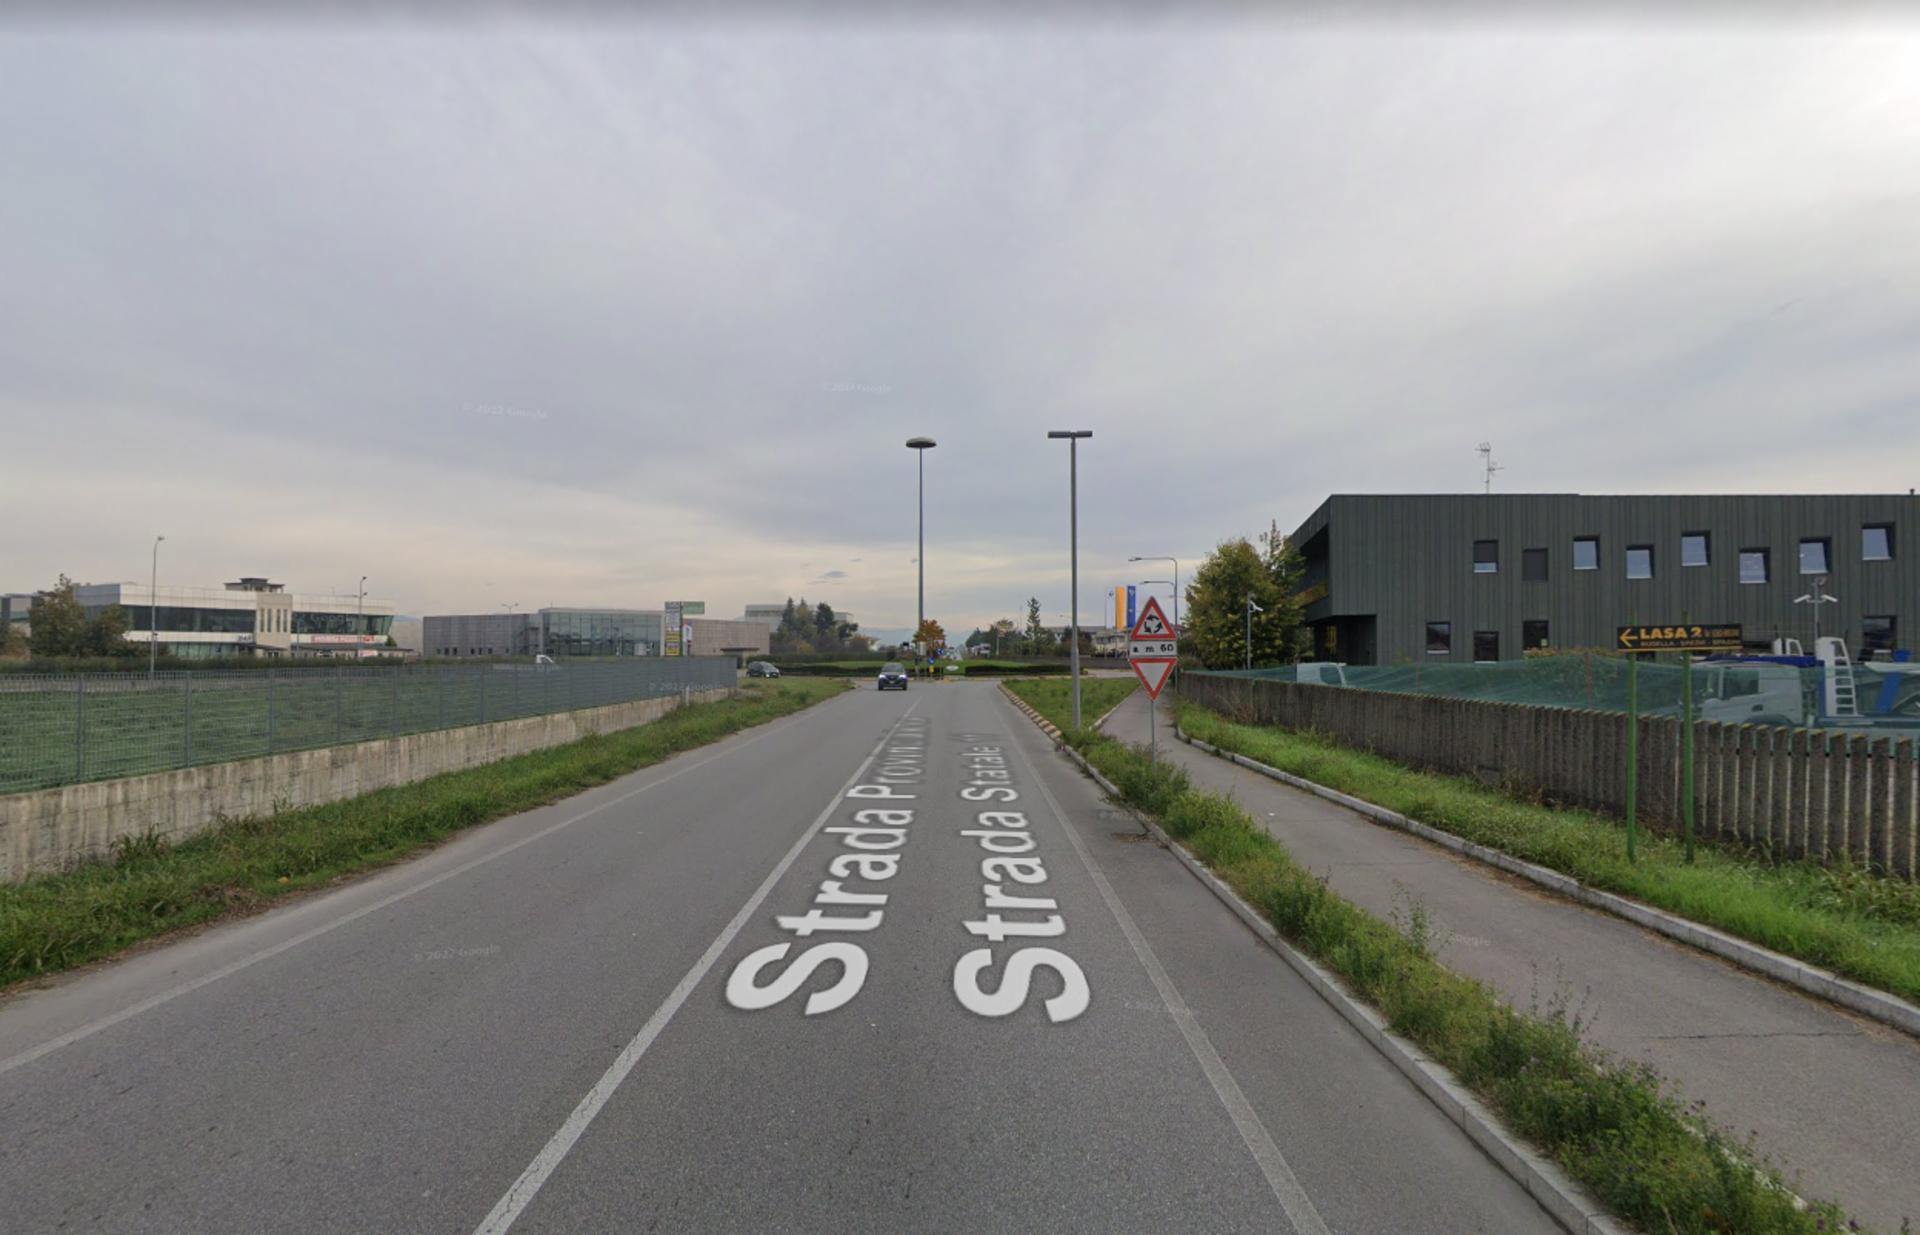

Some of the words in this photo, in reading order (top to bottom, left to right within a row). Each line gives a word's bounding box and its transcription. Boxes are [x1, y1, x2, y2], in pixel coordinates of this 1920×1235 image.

[1640, 627, 1688, 639] LASA
[1690, 626, 1702, 638] 2
[1160, 643, 1174, 652] 60
